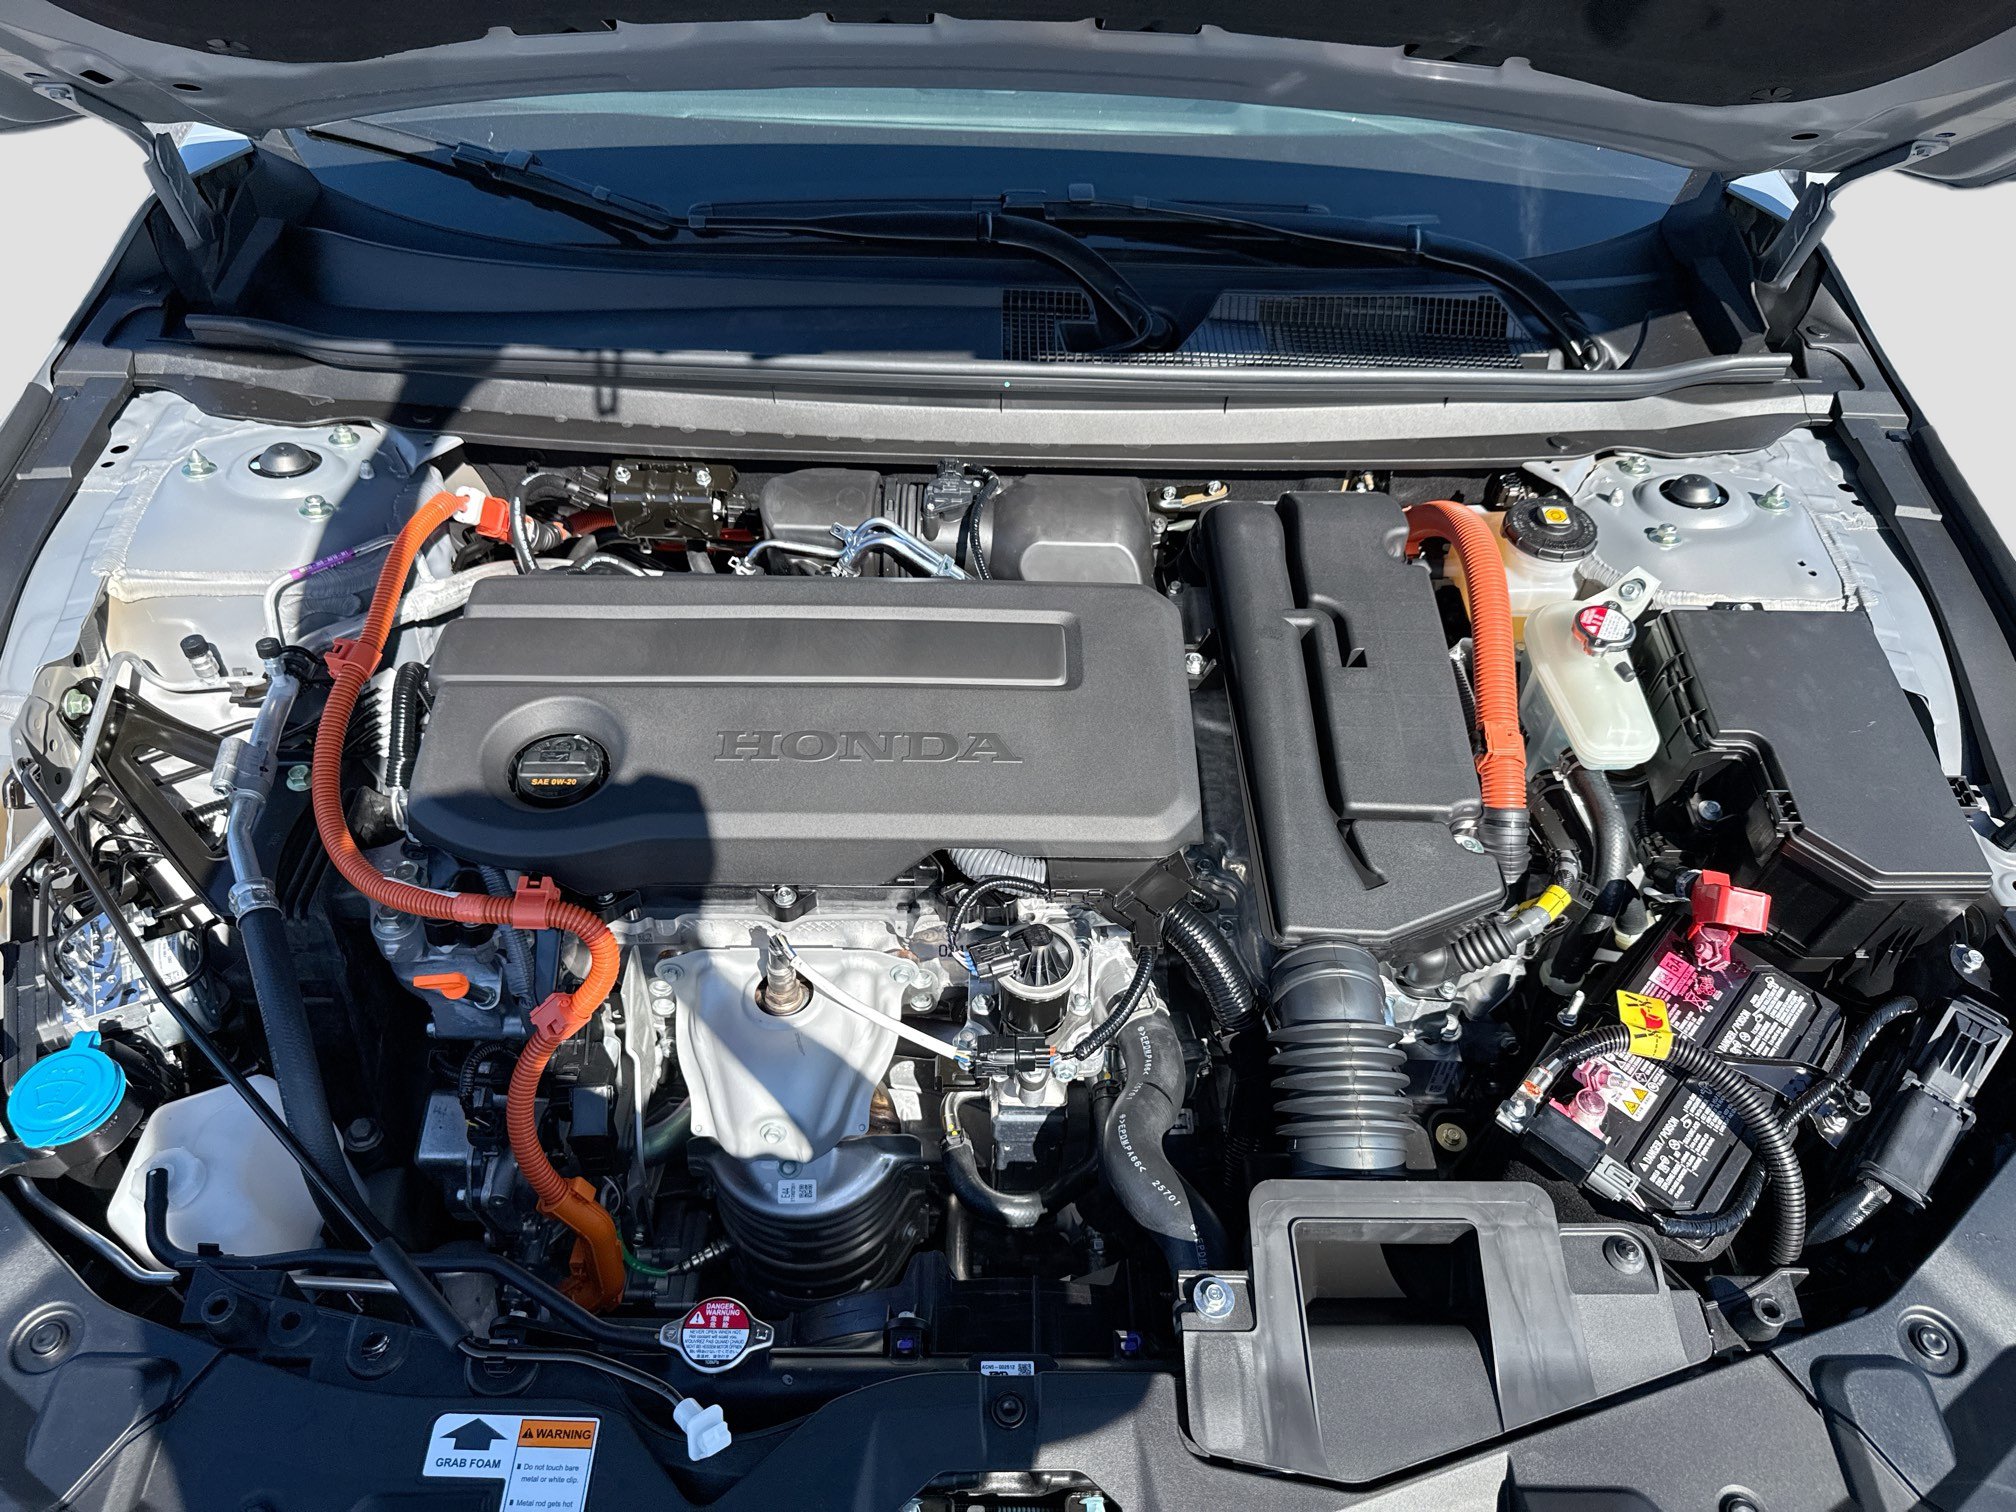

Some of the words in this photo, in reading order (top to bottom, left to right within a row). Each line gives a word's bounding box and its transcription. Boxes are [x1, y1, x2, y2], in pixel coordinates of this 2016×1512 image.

[714, 730, 1023, 763] HONDA
[1666, 956, 1683, 972] 5A
[1151, 1179, 1181, 1207] 25701
[536, 1428, 592, 1440] WARNING
[436, 1458, 466, 1468] GRAB
[469, 1458, 501, 1468] FOAM
[564, 1464, 580, 1472] bare
[560, 1500, 573, 1508] hot
